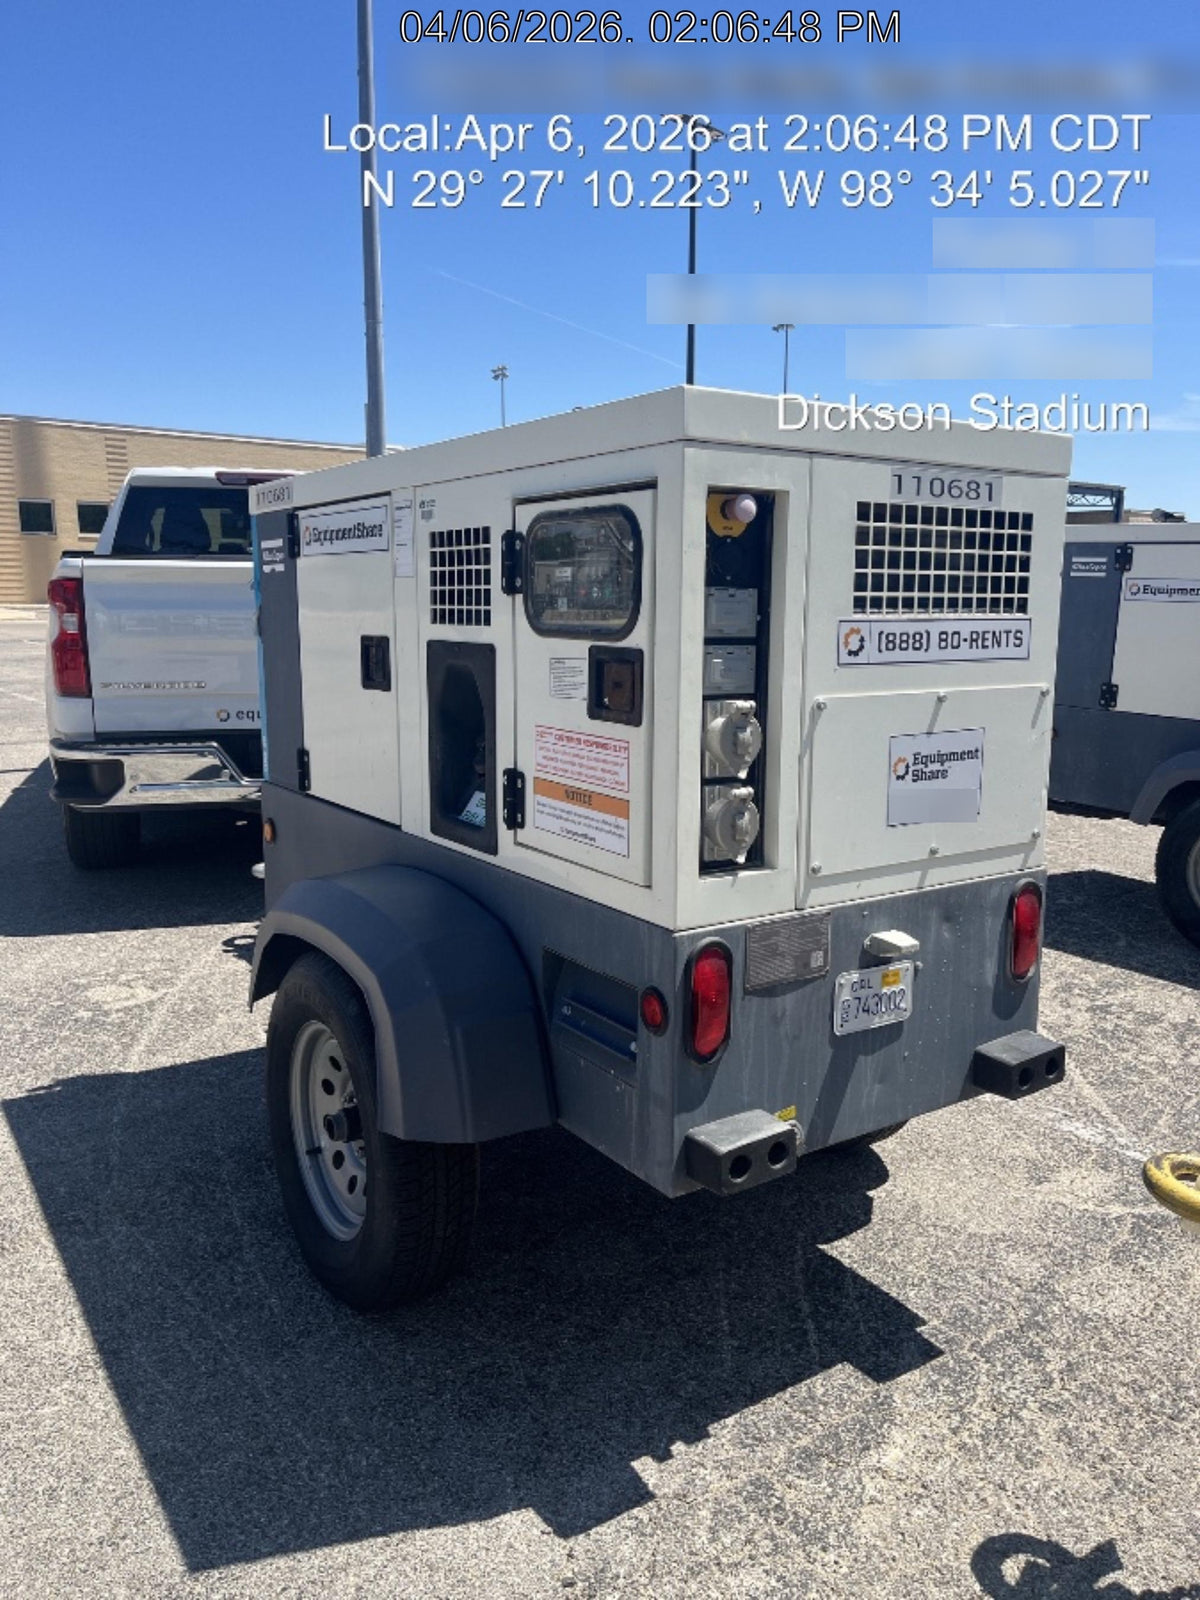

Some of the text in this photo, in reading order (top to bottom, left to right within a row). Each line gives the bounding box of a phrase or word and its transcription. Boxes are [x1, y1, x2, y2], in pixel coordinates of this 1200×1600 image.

[892, 473, 995, 502] 110681
[312, 521, 384, 547] EquipmentShare
[877, 630, 931, 653] (888)
[912, 747, 980, 768] Equipment
[911, 769, 949, 783] Share
